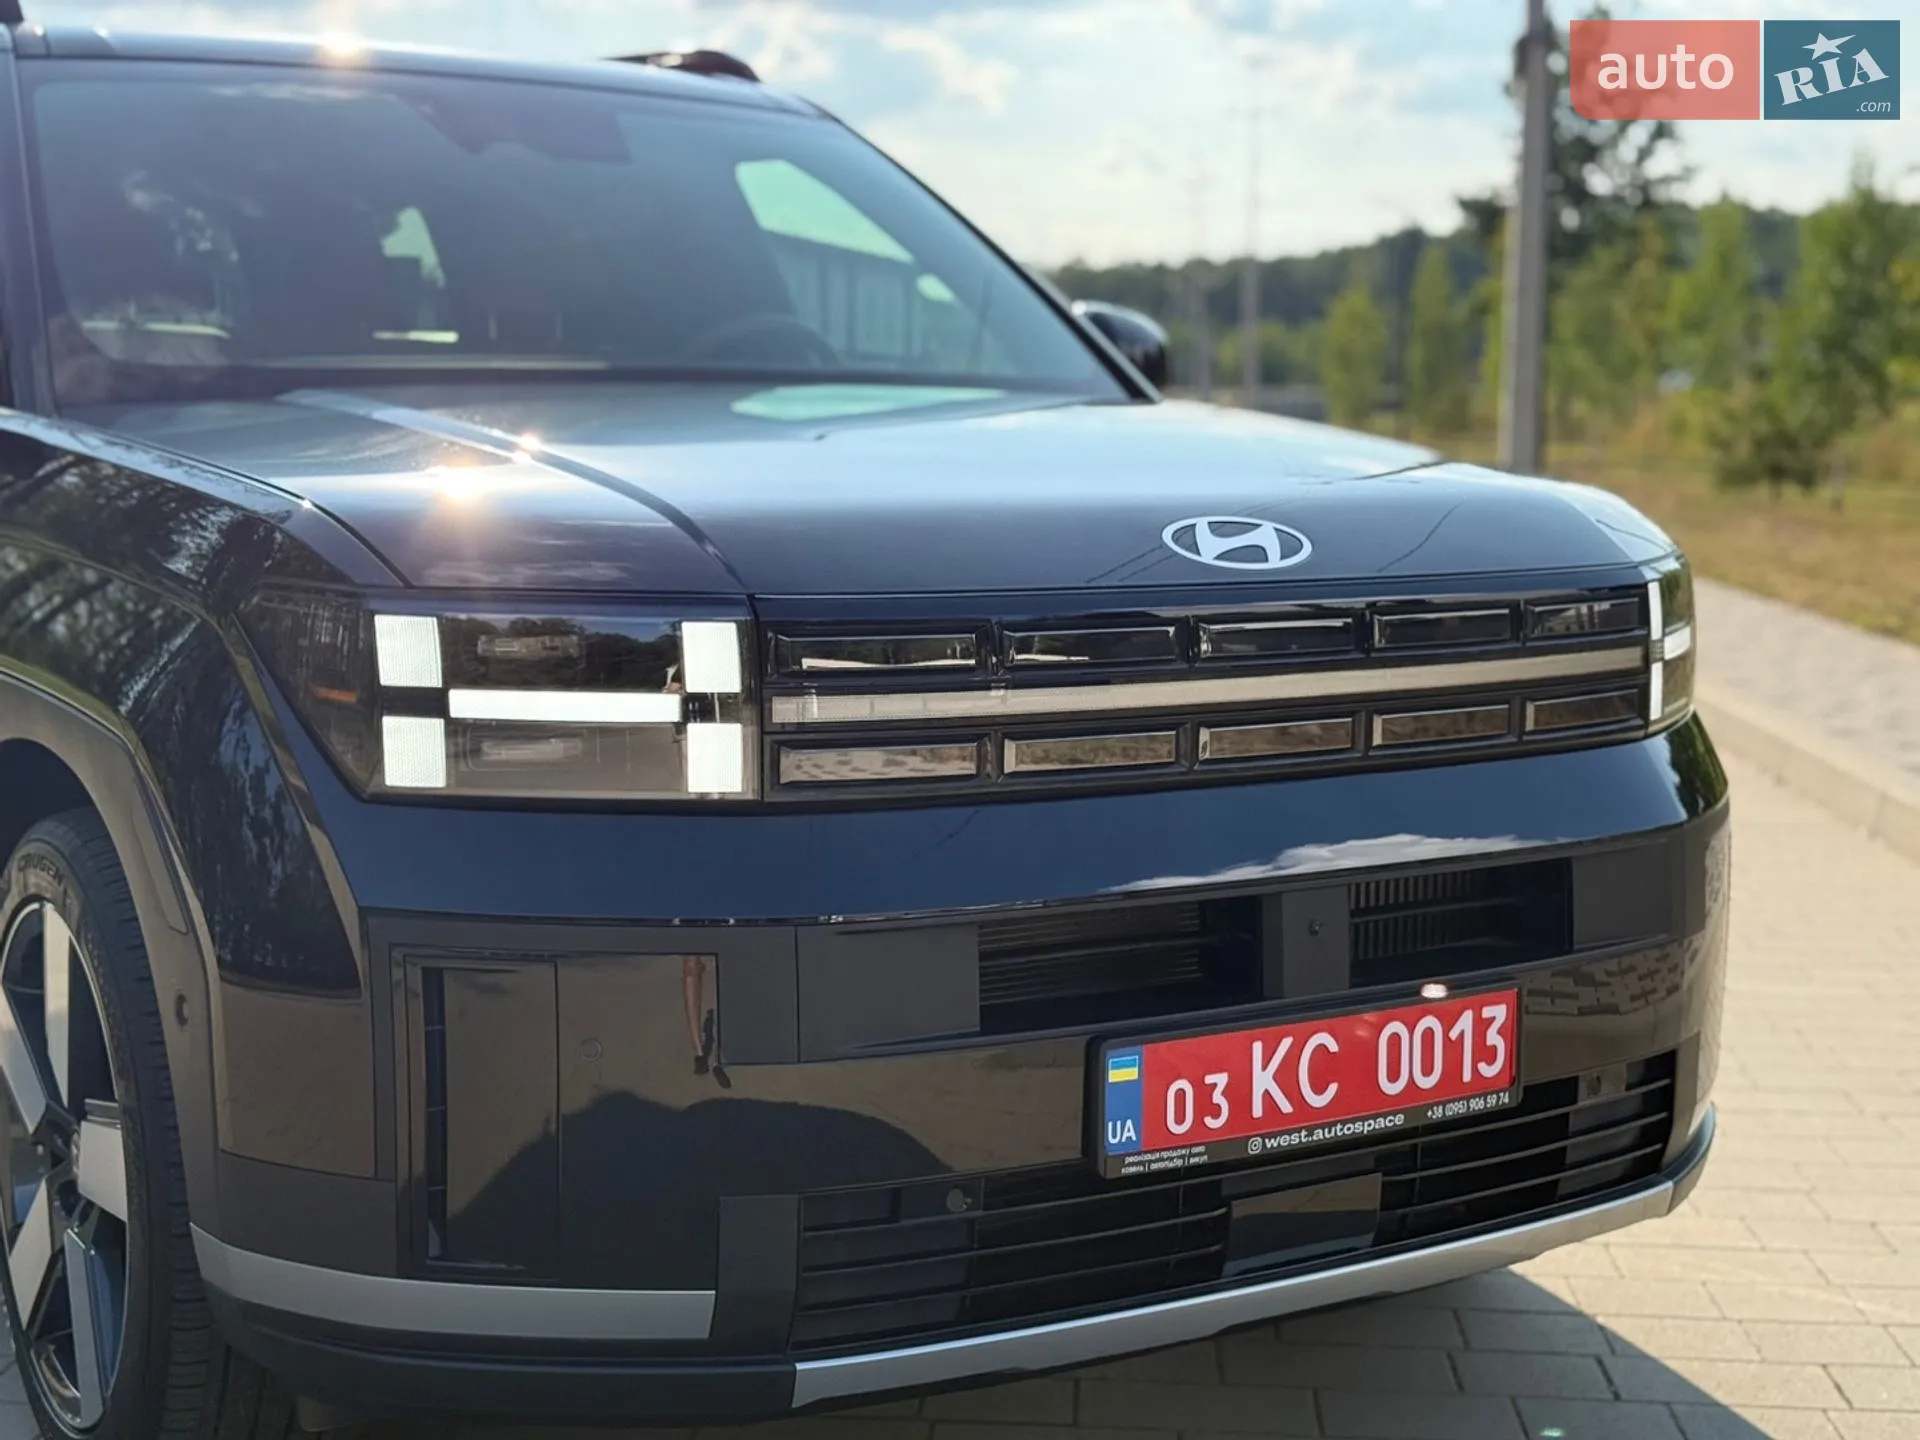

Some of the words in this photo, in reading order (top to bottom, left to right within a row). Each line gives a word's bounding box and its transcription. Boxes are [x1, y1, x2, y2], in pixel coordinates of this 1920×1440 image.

[1166, 1071, 1230, 1135] 03
[1251, 1031, 1339, 1119] KC
[1376, 1003, 1507, 1096] 0013
[1427, 1105, 1443, 1119] +38
[1445, 1100, 1467, 1116] (095)
[1469, 1096, 1485, 1111] 906
[1486, 1093, 1497, 1107] 59
[1498, 1091, 1509, 1105] 74
[1107, 1118, 1137, 1144] UA
[1264, 1113, 1405, 1150] west.autospace
